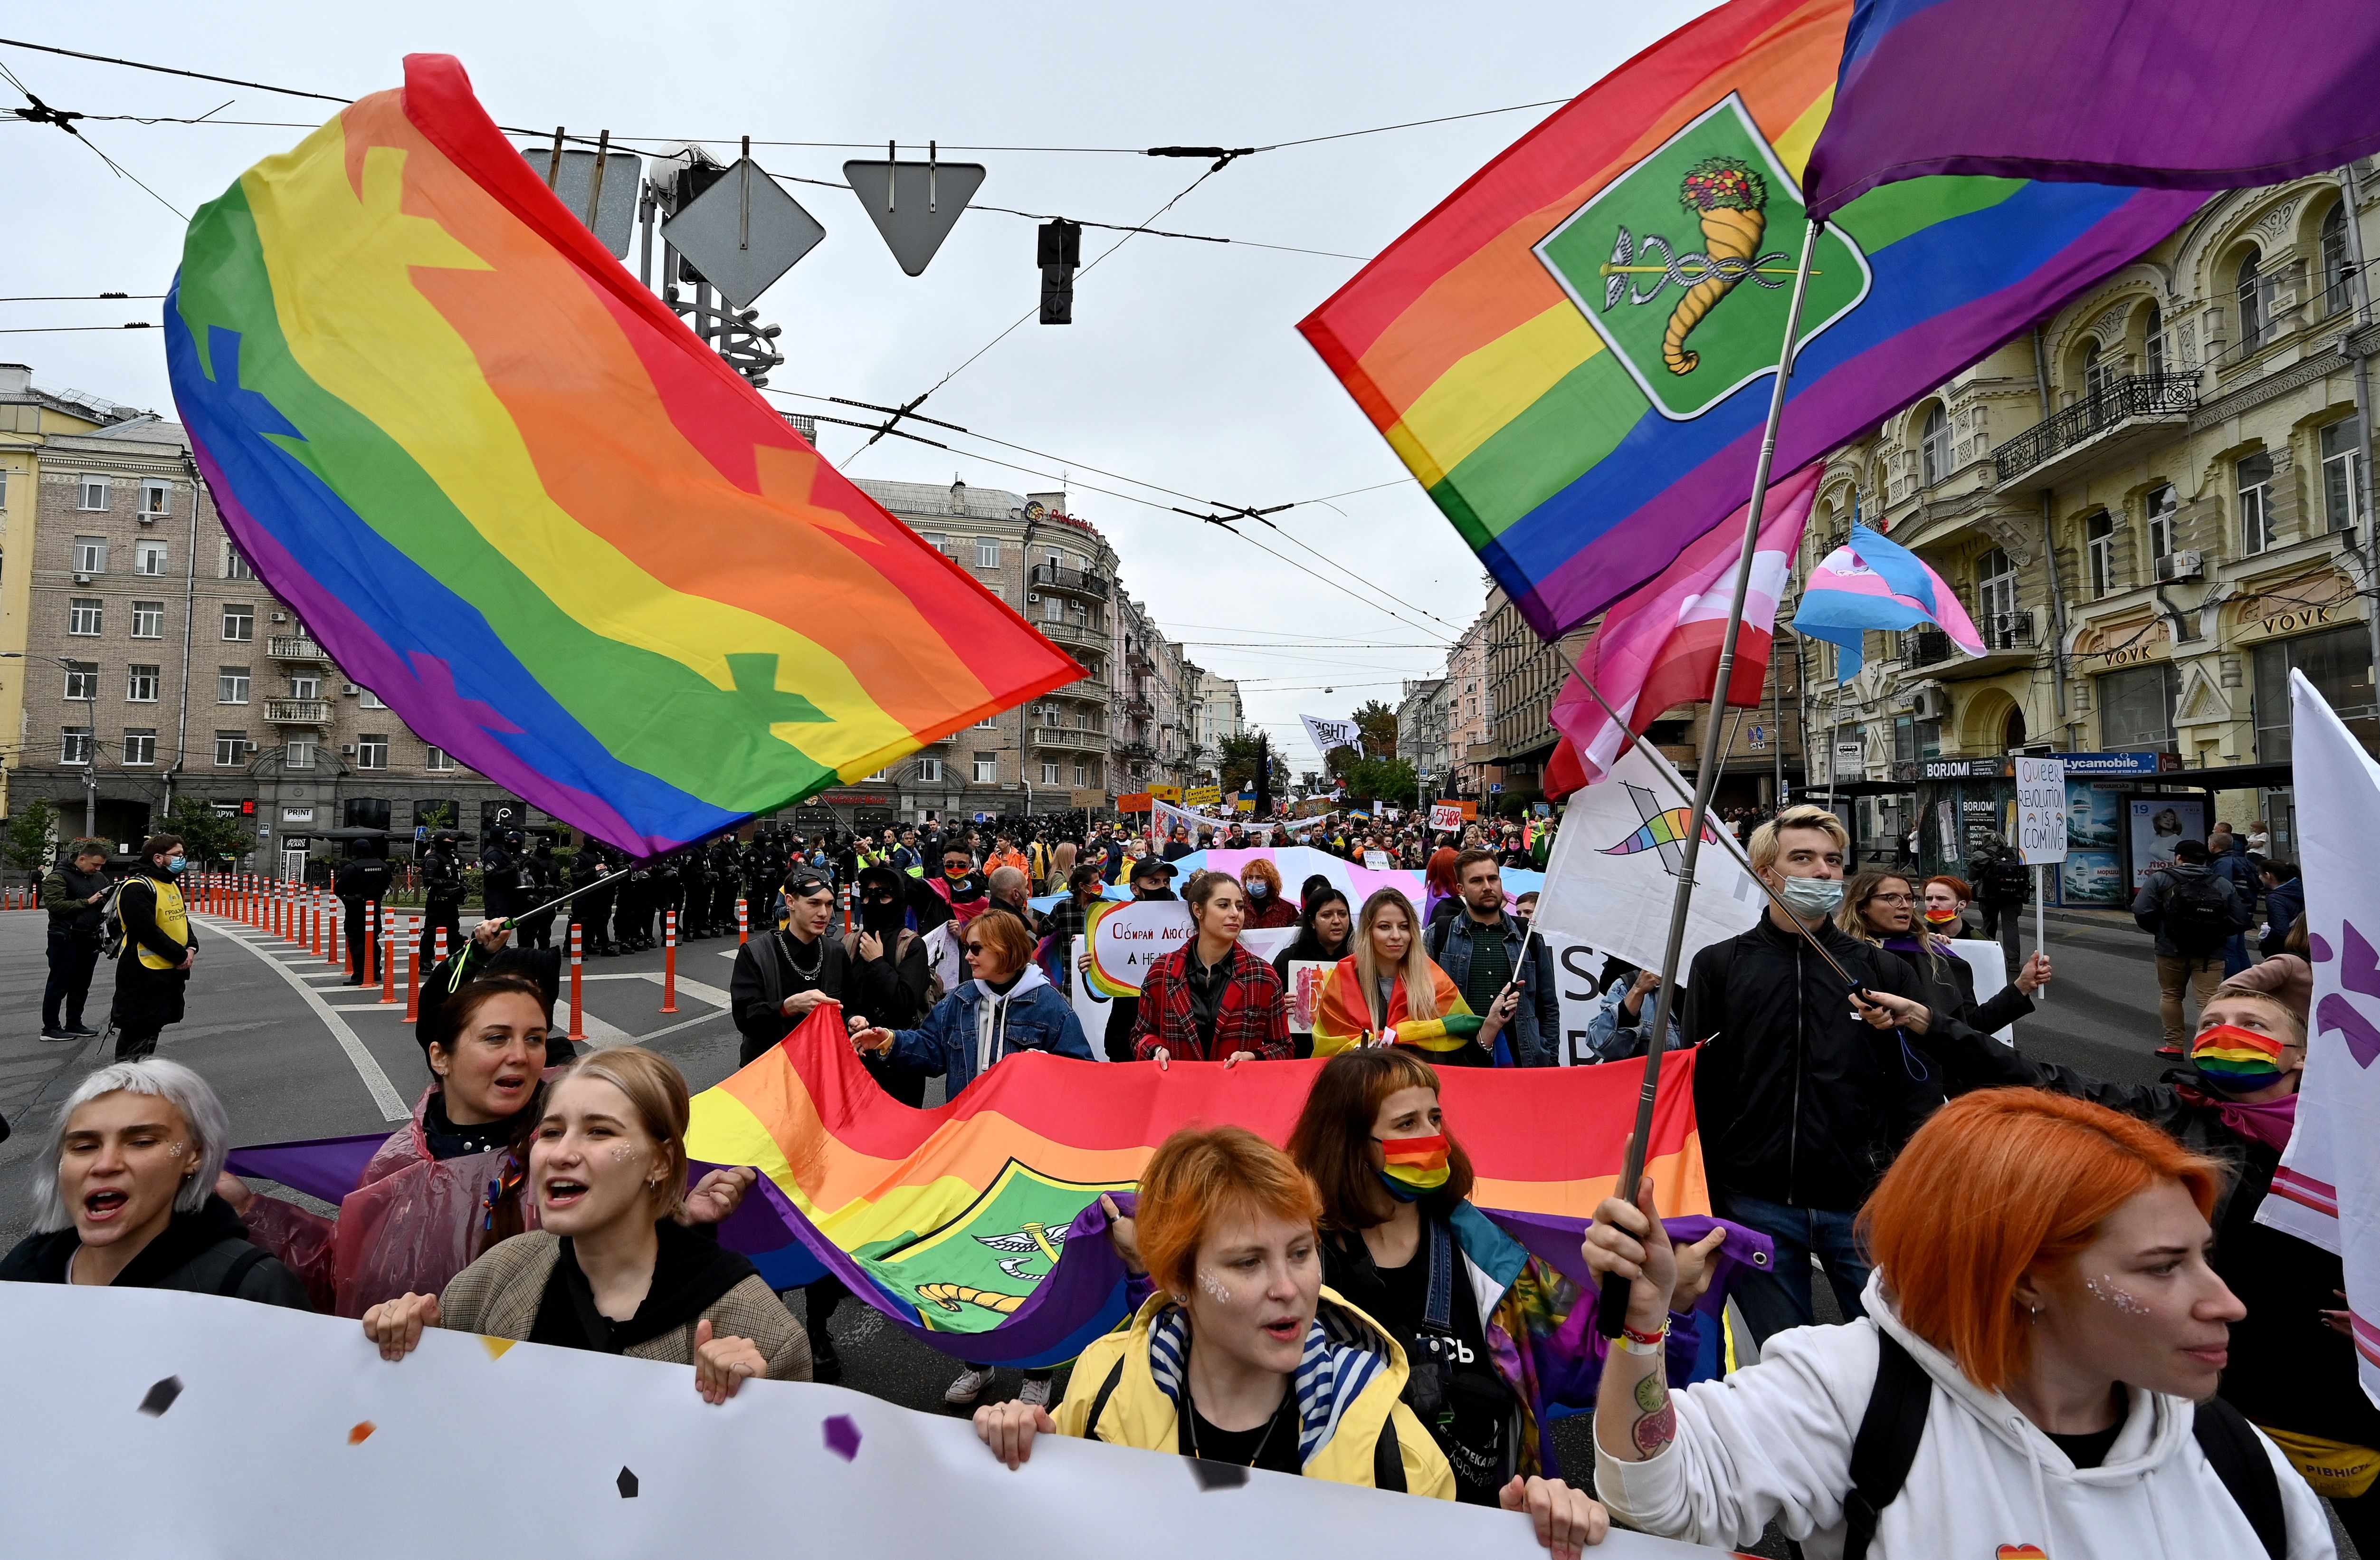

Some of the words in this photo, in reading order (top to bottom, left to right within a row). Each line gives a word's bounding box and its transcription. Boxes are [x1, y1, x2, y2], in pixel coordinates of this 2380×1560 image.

[2263, 607, 2330, 633] VOVK
[2104, 645, 2151, 666] VOVK
[1927, 762, 1970, 777] BORJOMI
[2064, 759, 2138, 769] Lycamobile
[1963, 801, 1995, 811] BORJOMI
[2133, 804, 2149, 814] 19
[1430, 808, 1460, 826] #5488
[2305, 1463, 2372, 1478] РІВНІСТЬ
